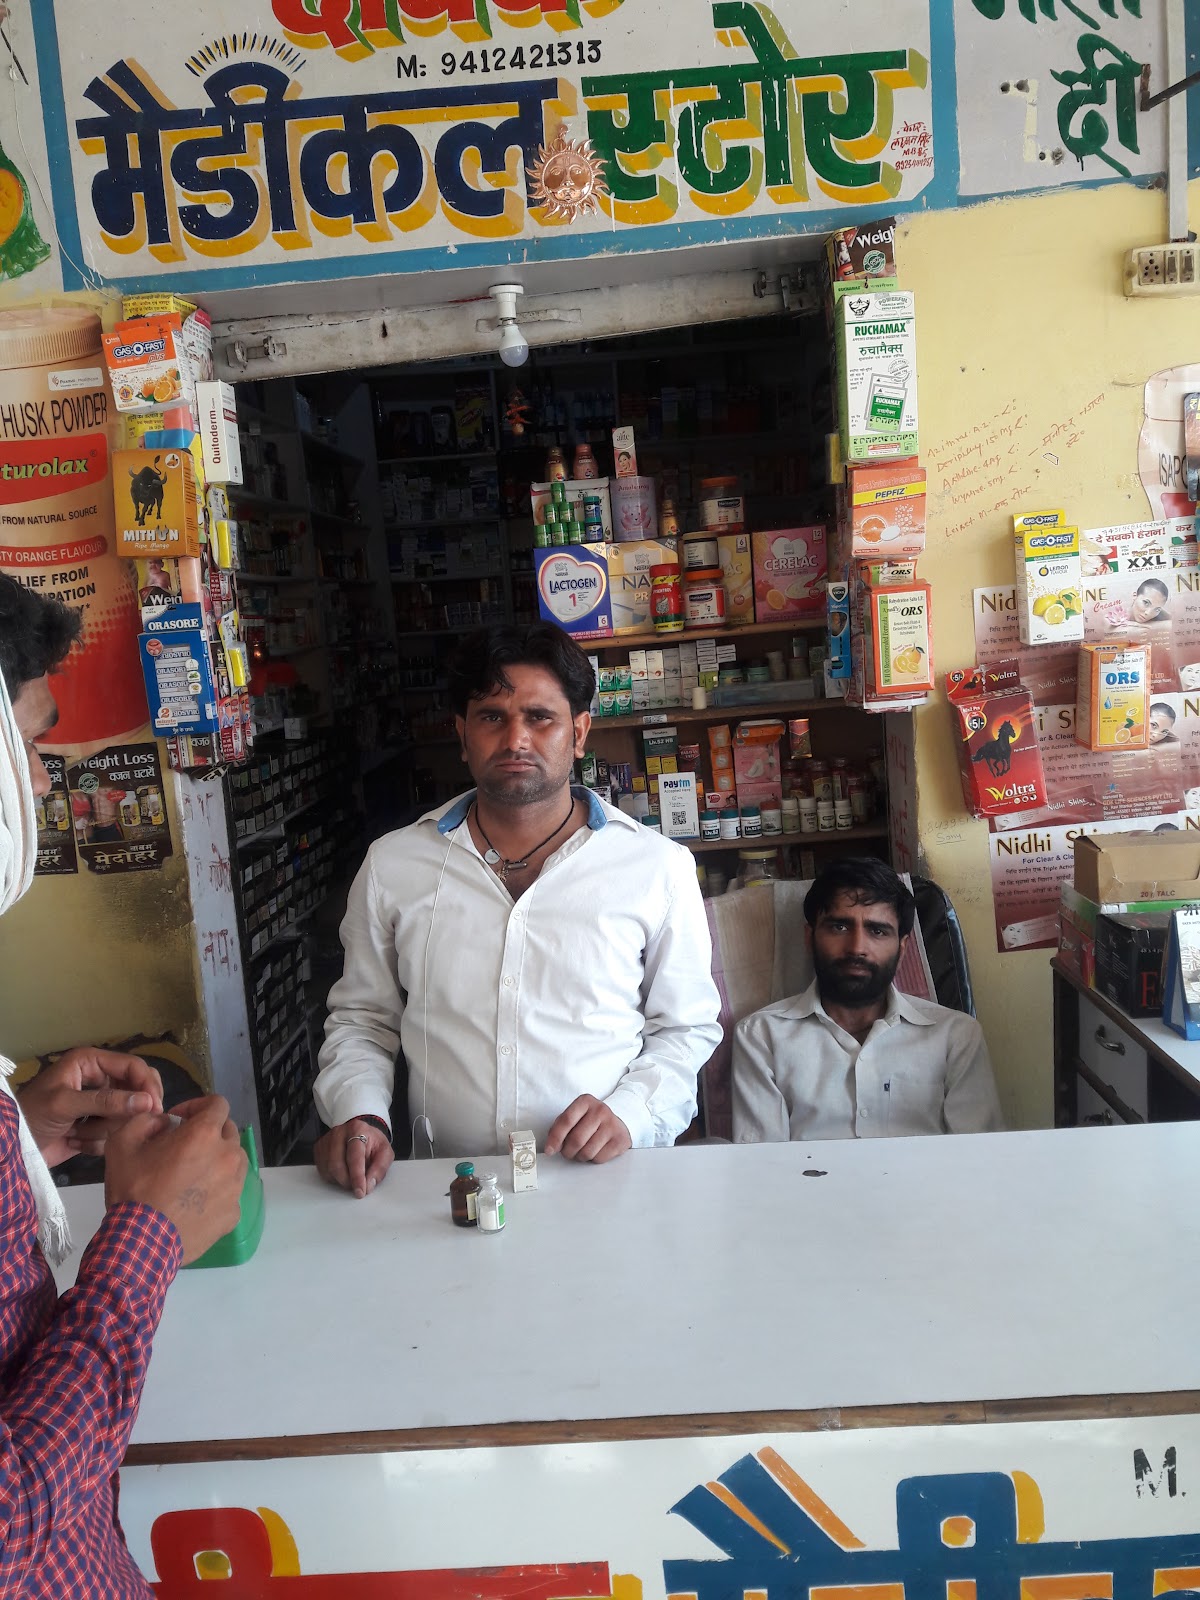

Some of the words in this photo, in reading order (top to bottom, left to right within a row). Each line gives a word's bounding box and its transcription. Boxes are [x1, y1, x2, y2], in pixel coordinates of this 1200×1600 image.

[397, 54, 426, 78] M:
[441, 39, 602, 75] 9412421313
[76, 58, 565, 250] मैडीकल
[854, 322, 907, 337] RUCHAMAX
[113, 339, 166, 357] GAS-O-FAST
[858, 341, 903, 357] रुचामैक्स
[1, 400, 50, 438] HUSK
[50, 392, 108, 433] POWDER
[209, 409, 222, 465] Quitoderm
[0, 456, 89, 481] turolax
[875, 487, 906, 499] PEPFIZ
[2, 515, 26, 525] FROM
[27, 512, 67, 525] NATURAL
[68, 505, 98, 520] SOURCE
[1023, 513, 1059, 526] GAS-O-FAST
[123, 524, 180, 543] MITHUN
[813, 530, 822, 538] 12
[1029, 533, 1076, 549] GAS-O-FAST
[1106, 531, 1135, 543] सबको
[0, 550, 12, 562] TY
[15, 549, 58, 562] ORANGE
[60, 540, 103, 560] FLAVOUR
[763, 555, 819, 571] CERELAC
[1127, 555, 1167, 570] XXL
[51, 566, 89, 586] FROM
[891, 568, 913, 576] ORS
[549, 577, 598, 595] LACTOGEN
[622, 574, 651, 591] NA
[568, 592, 578, 608] 1
[634, 591, 649, 603] PR
[981, 589, 1017, 614] Nid
[900, 605, 924, 617] ORS
[1094, 599, 1123, 613] Cream
[147, 617, 200, 631] ORASORE
[987, 670, 1018, 682] Woltra
[1105, 670, 1141, 686] ORS
[160, 707, 171, 719] 2
[1051, 743, 1068, 751] Action
[42, 760, 62, 769] oss
[78, 753, 120, 771] Weight
[123, 753, 155, 766] Loss
[50, 771, 62, 783] टायें
[108, 771, 131, 782] वजन
[663, 779, 691, 789] paytm
[985, 782, 1037, 801] Woltra
[1047, 801, 1066, 812] Nidhi
[1068, 796, 1087, 807] Shine
[996, 833, 1052, 857] Nidhi
[94, 849, 158, 867] मेदोहर
[1036, 855, 1054, 863] Clear
[1043, 865, 1058, 873] Triple
[1132, 1446, 1188, 1500] M.
